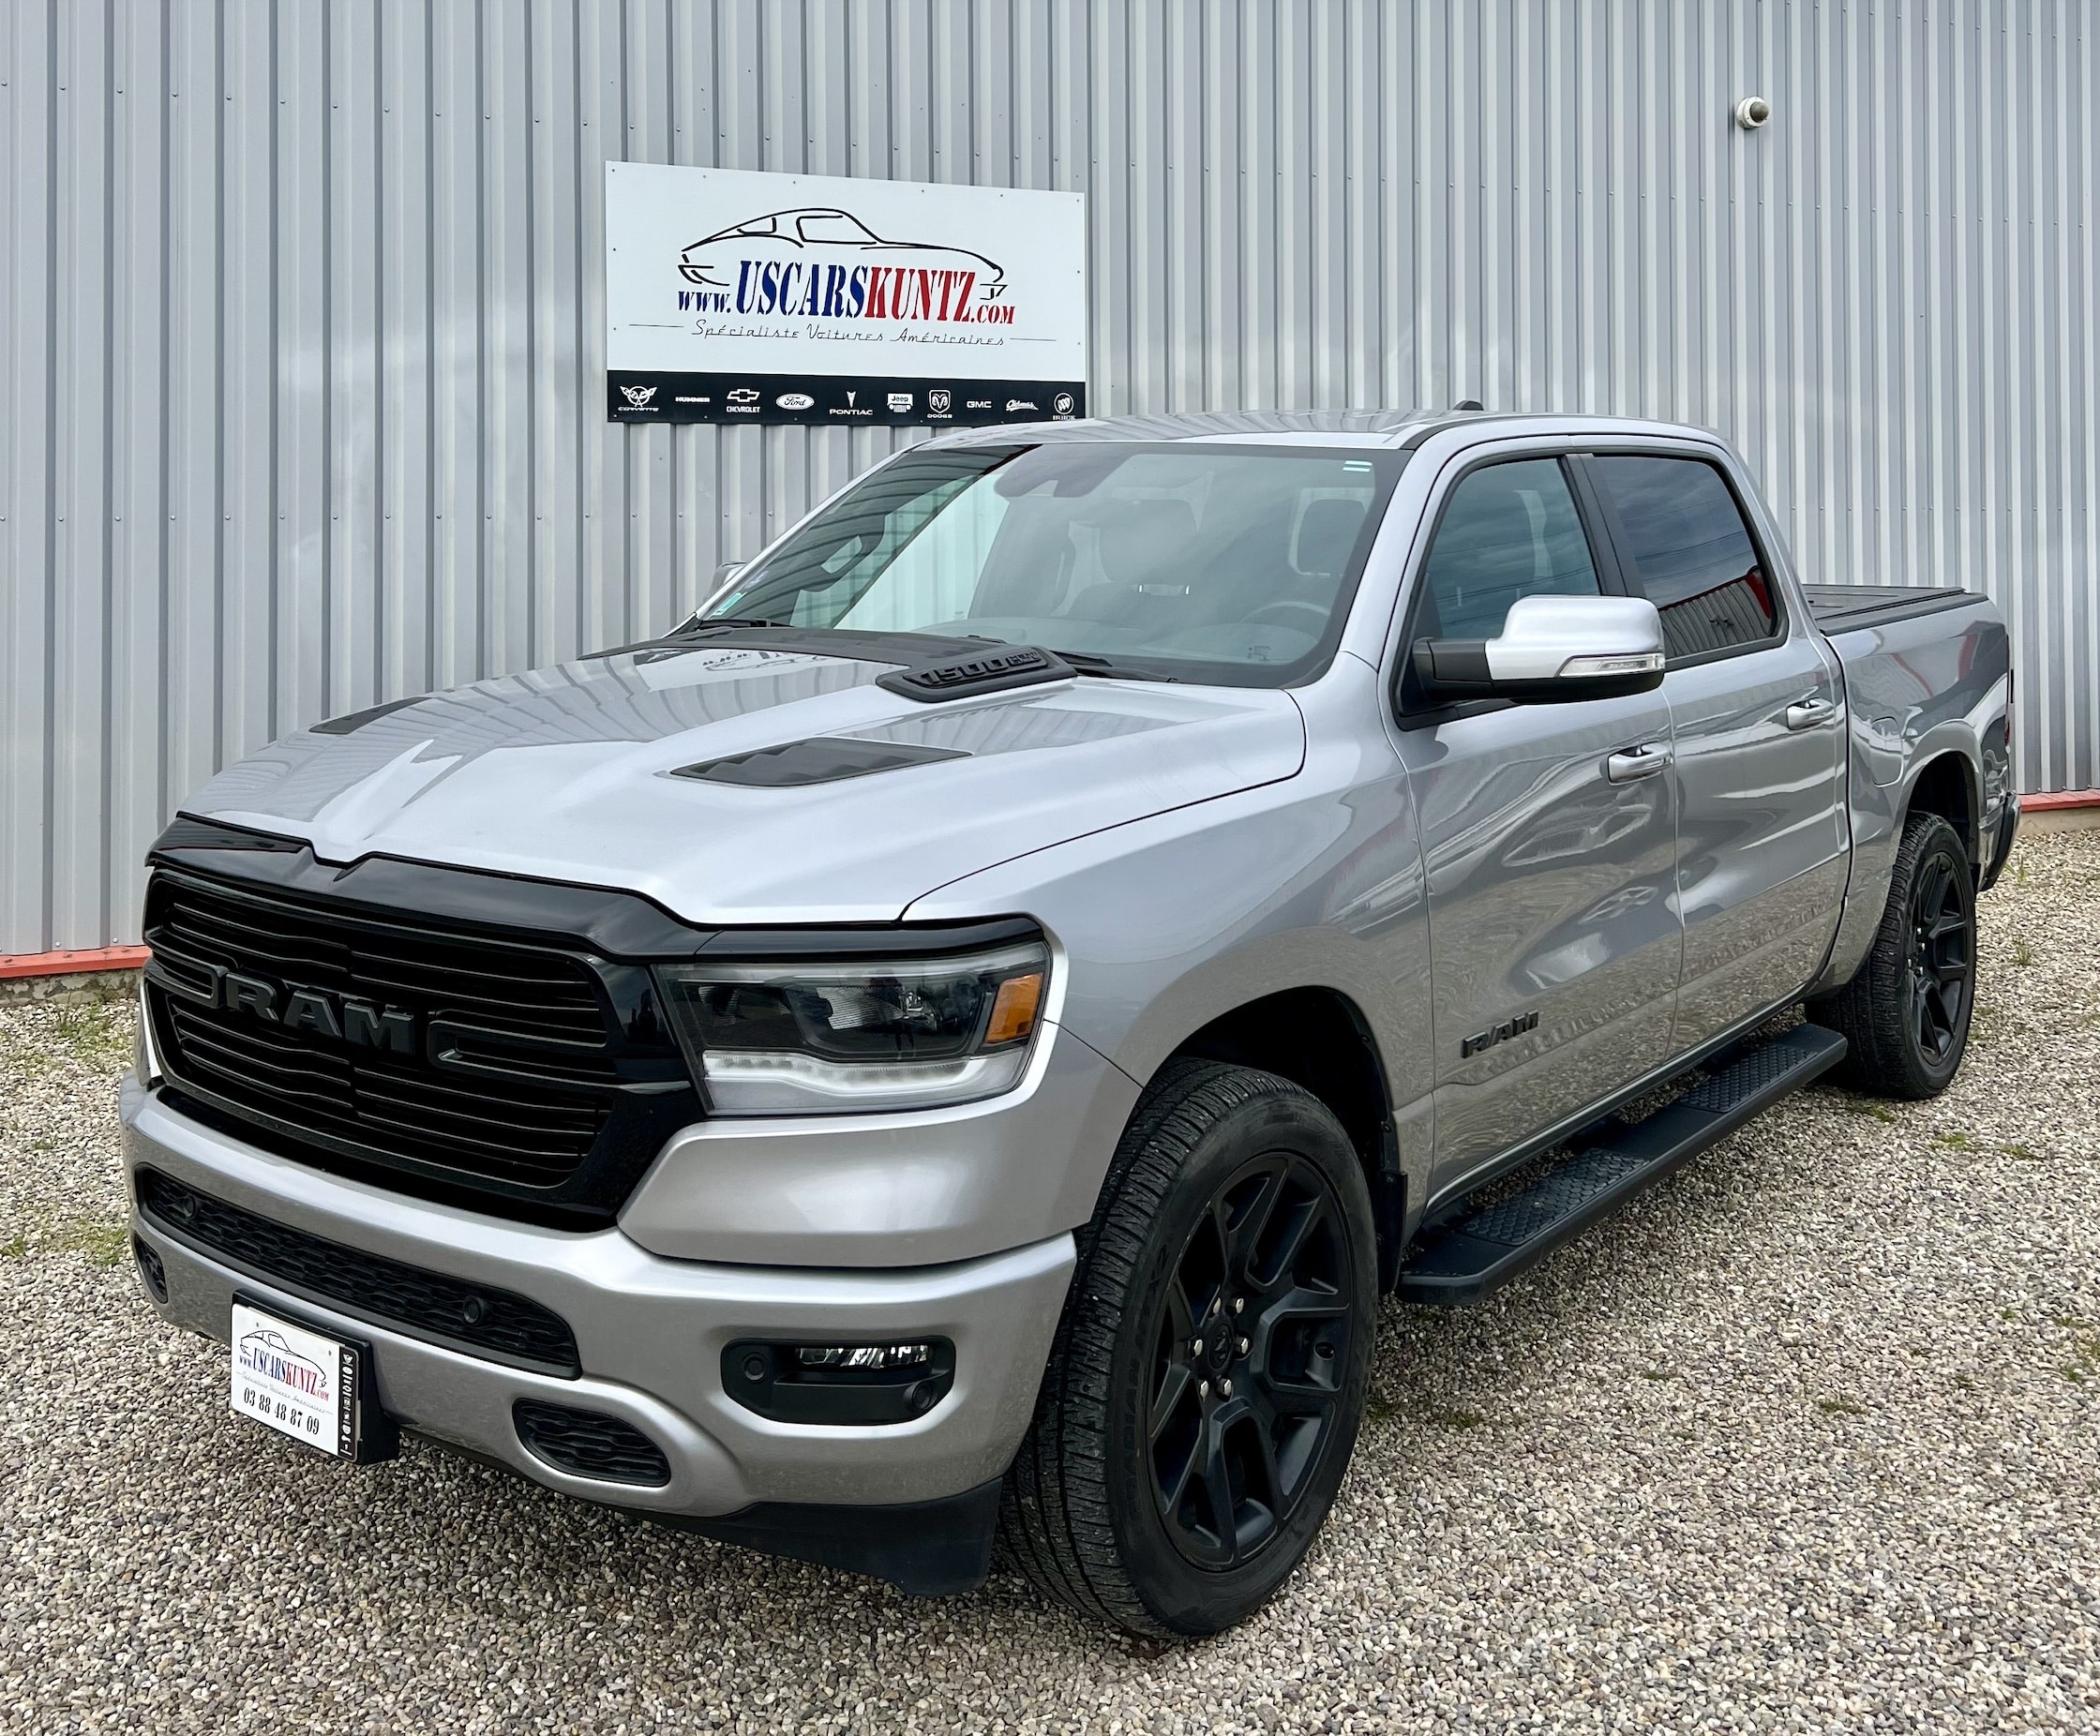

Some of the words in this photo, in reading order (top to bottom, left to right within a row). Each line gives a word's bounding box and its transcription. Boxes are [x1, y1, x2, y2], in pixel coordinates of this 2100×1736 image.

[691, 319, 800, 339] Spécialiste
[806, 323, 883, 342] Voitures
[890, 328, 1005, 346] Américaines
[784, 397, 806, 407] Ford
[891, 395, 909, 403] Jeep
[967, 400, 992, 409] GMC
[921, 656, 1006, 684] 1500
[226, 971, 414, 1055] RAM
[1461, 1010, 1538, 1059] RAM
[244, 1387, 256, 1407] 03
[259, 1394, 271, 1414] 88
[274, 1402, 287, 1421] 48
[290, 1410, 303, 1429] 87
[307, 1415, 320, 1435] 09
